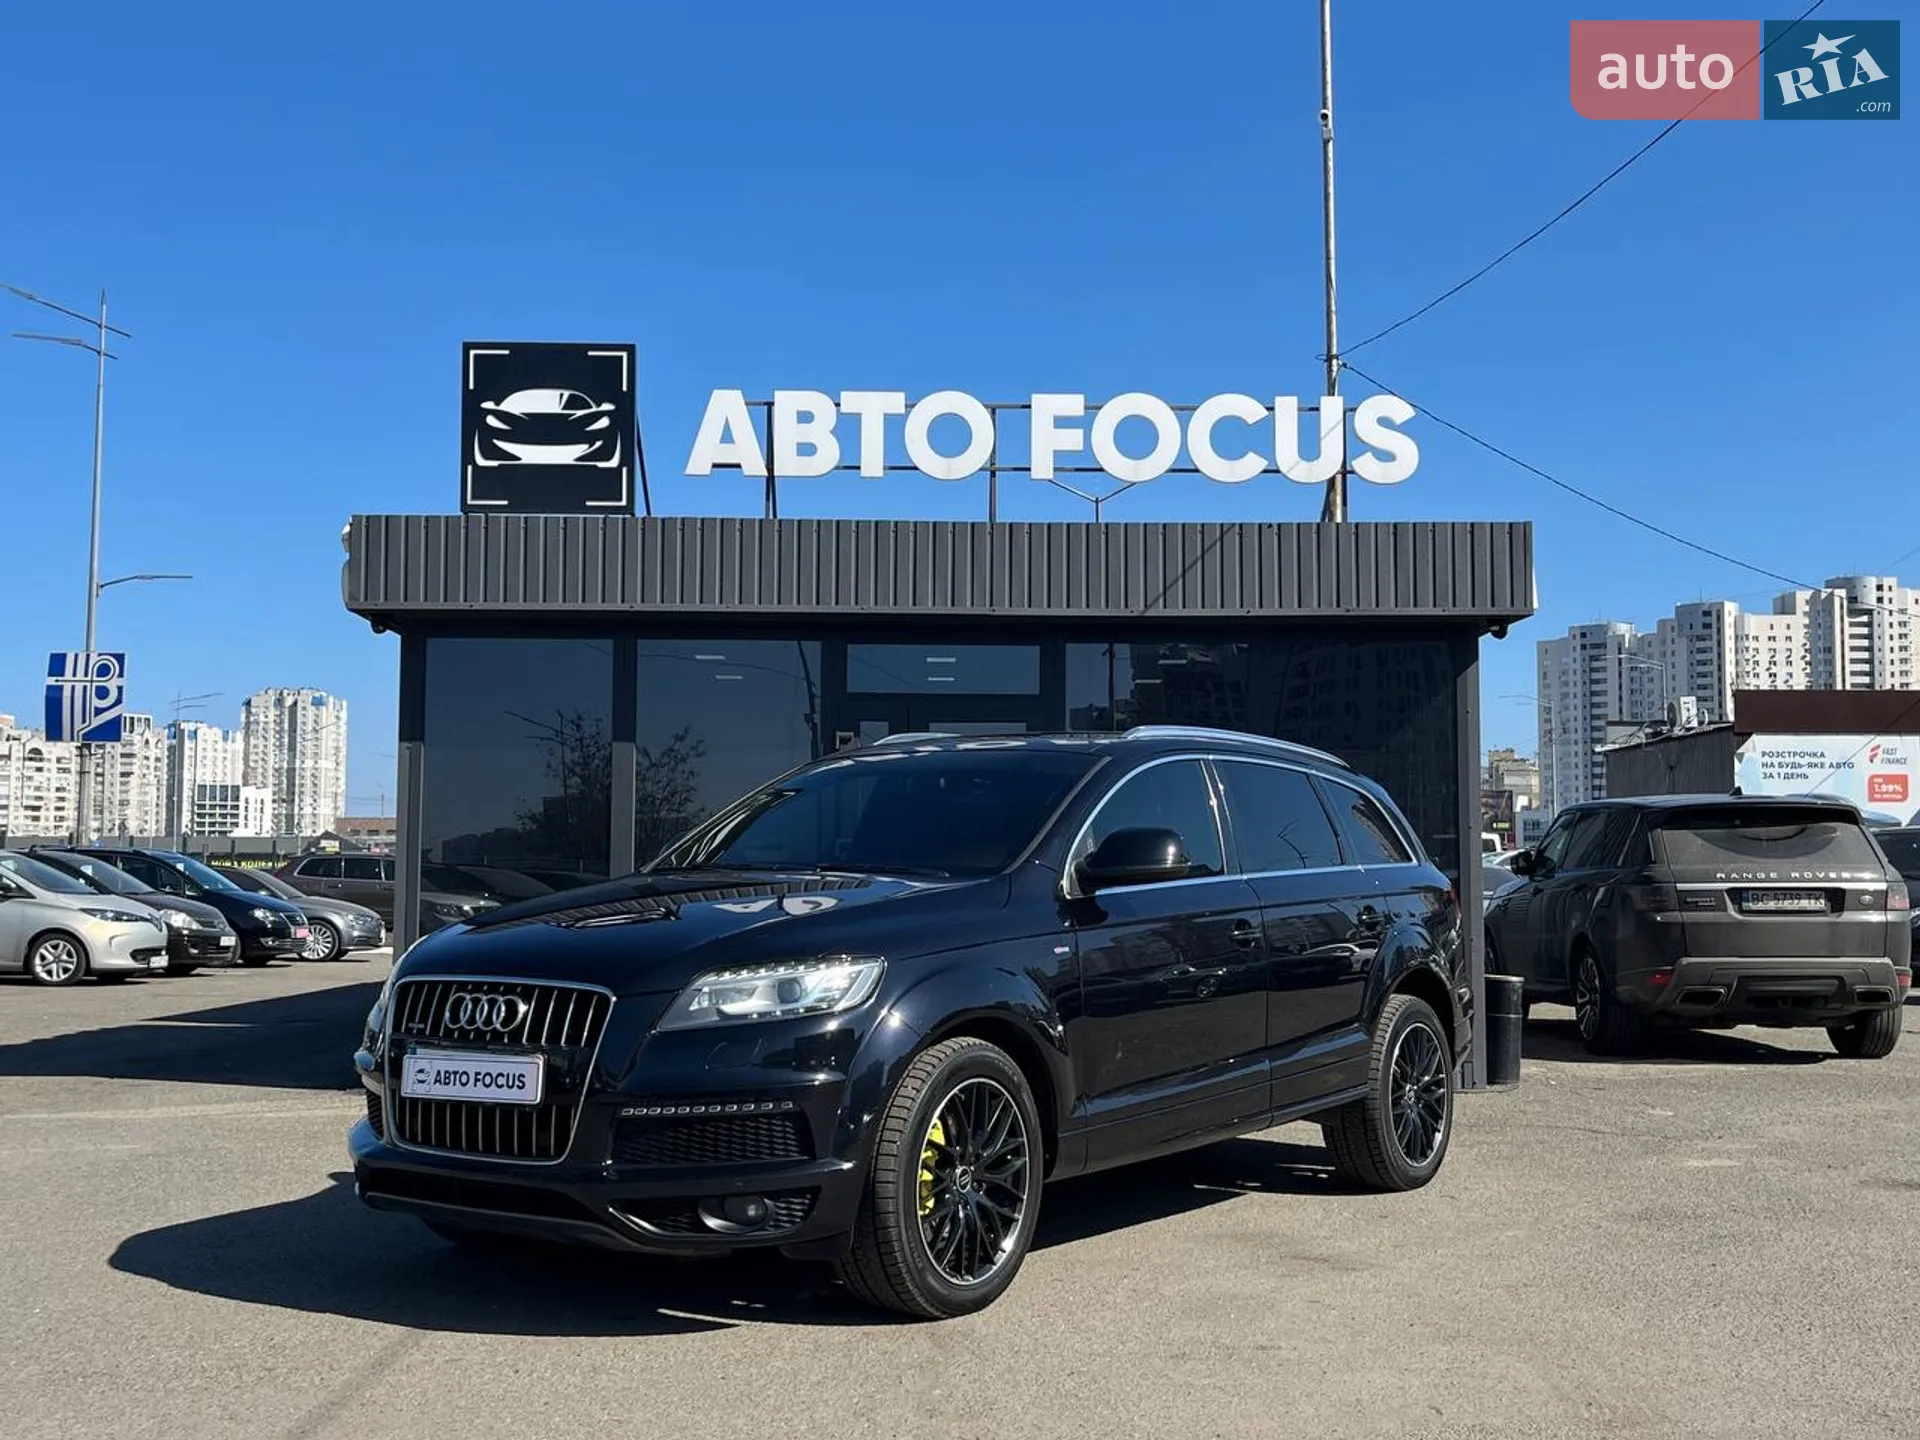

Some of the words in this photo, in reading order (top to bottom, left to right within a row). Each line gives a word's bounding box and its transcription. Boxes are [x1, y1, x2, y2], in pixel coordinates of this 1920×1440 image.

[684, 389, 996, 481] АВТО
[1030, 392, 1420, 485] FOCUS
[1761, 750, 1826, 759] РОЗСТРОЧКА
[1761, 761, 1775, 769] НА
[1778, 761, 1825, 770] БУДЬ-ЯКЕ
[1828, 761, 1855, 770] АВТО
[1762, 772, 1775, 780] ЗА
[1783, 772, 1809, 781] ДЕНЬ
[1716, 871, 1779, 879] RANGE
[1790, 871, 1852, 879] ROVER
[433, 1069, 470, 1087] АВТО
[473, 1071, 526, 1090] FOCUS
